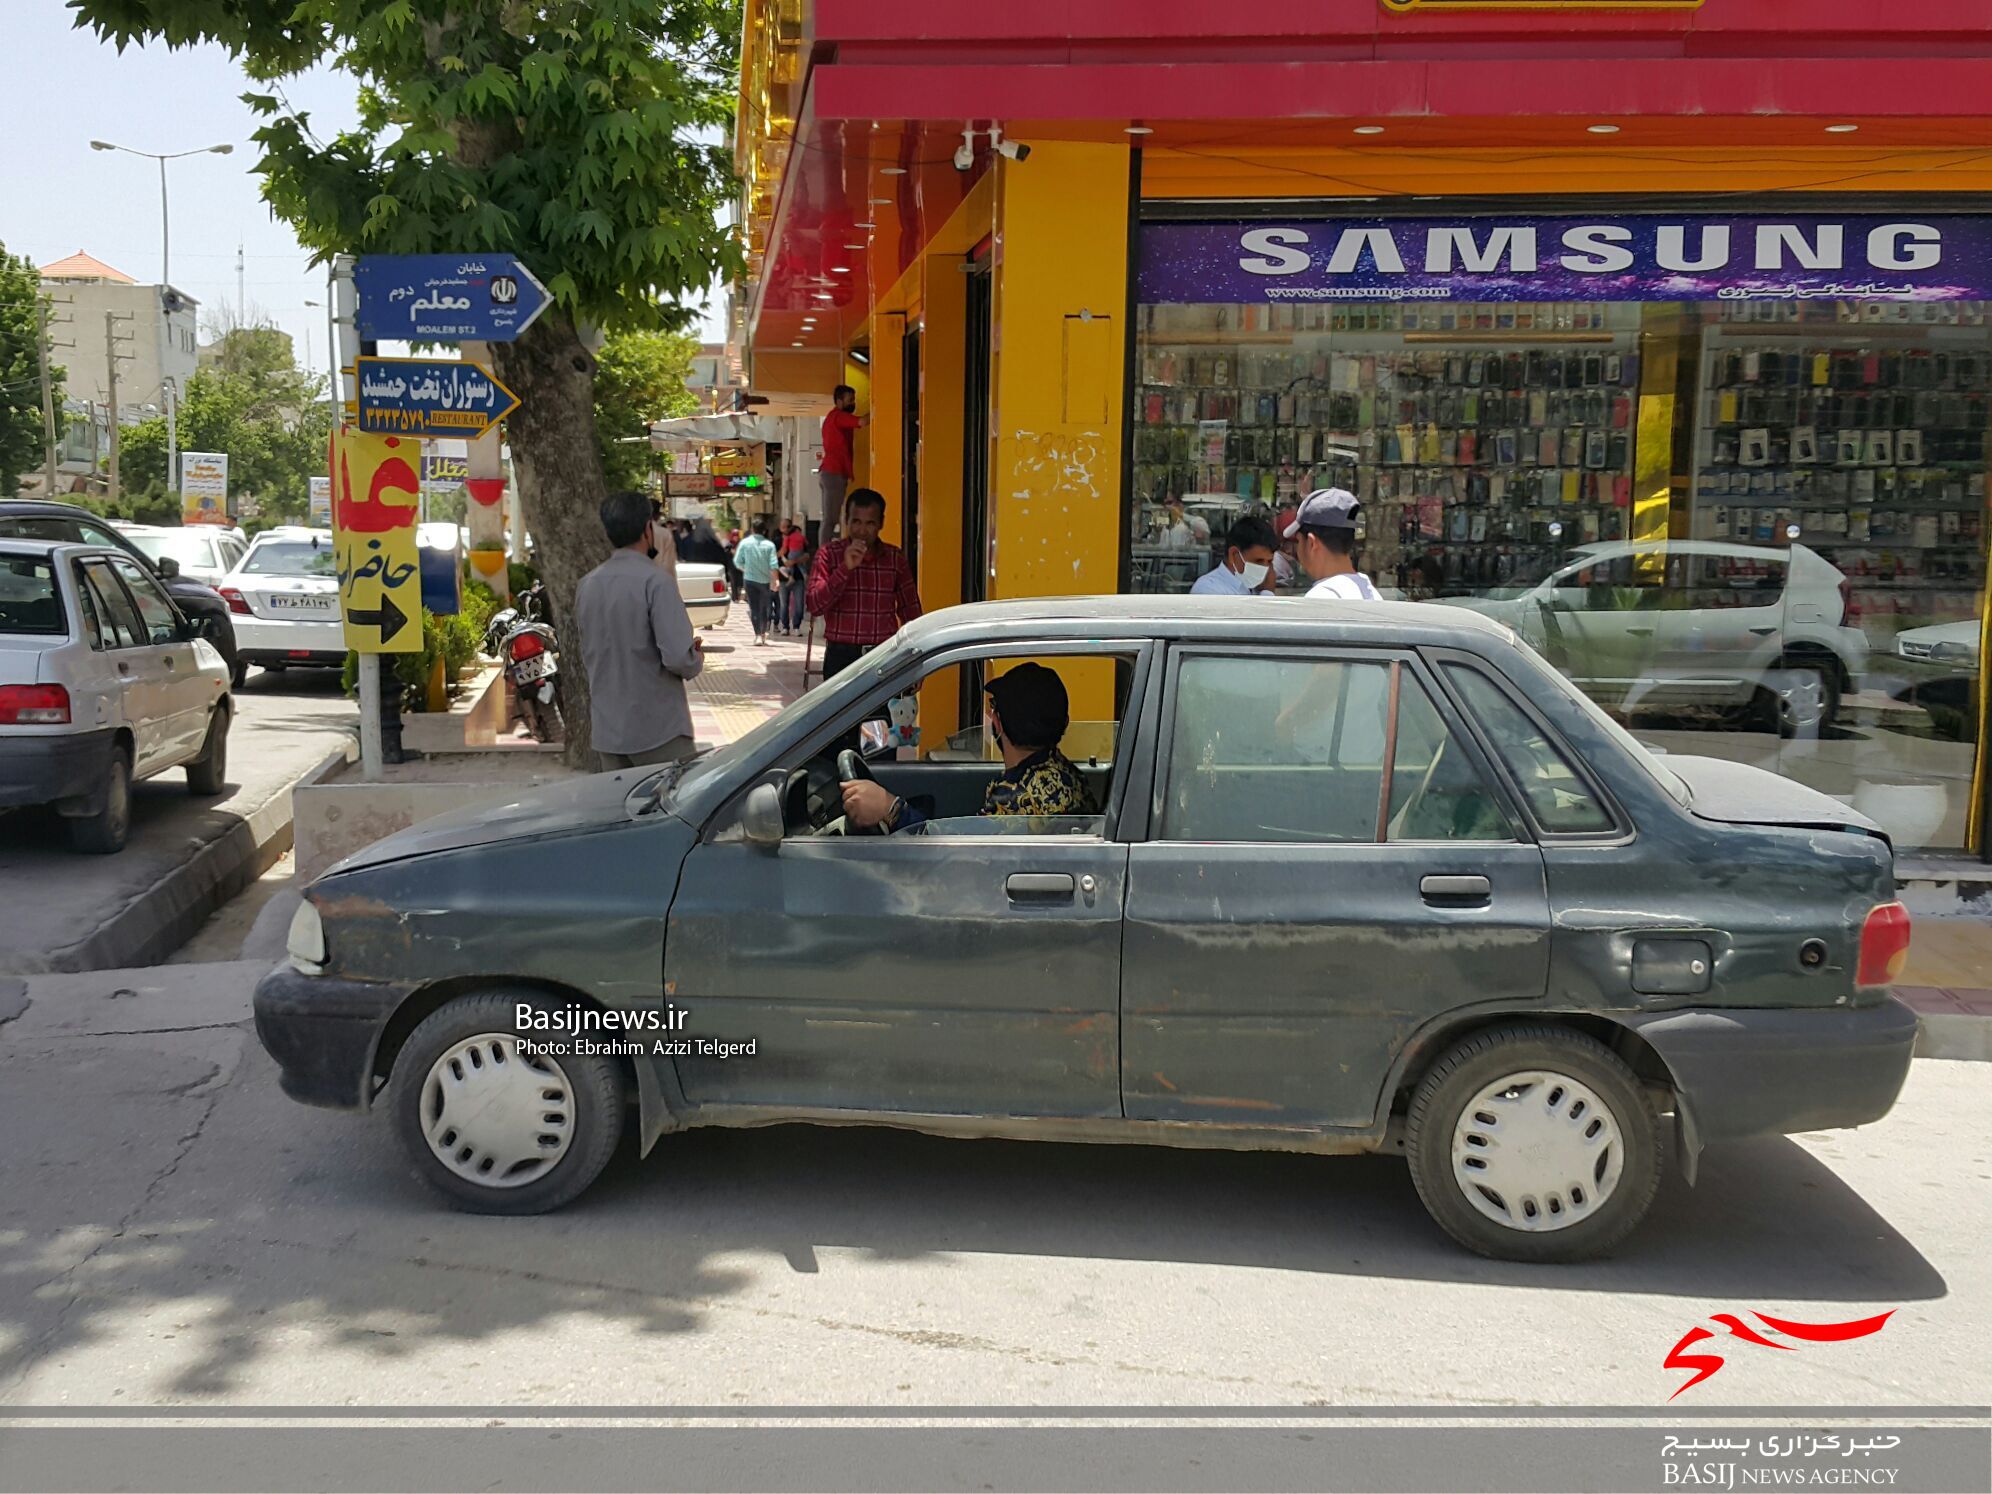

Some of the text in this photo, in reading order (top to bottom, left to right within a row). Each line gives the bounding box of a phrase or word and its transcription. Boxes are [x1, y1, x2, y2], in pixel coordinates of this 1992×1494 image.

[1239, 224, 1942, 275] SAMSUNG
[457, 262, 487, 275] خیابان
[1264, 286, 1452, 300] www.samsung.com
[389, 285, 471, 322] معلم دوم
[416, 325, 457, 334] MOALEM
[362, 367, 495, 409] رستوران تخت جمشید
[432, 412, 487, 426] RESTAURANT
